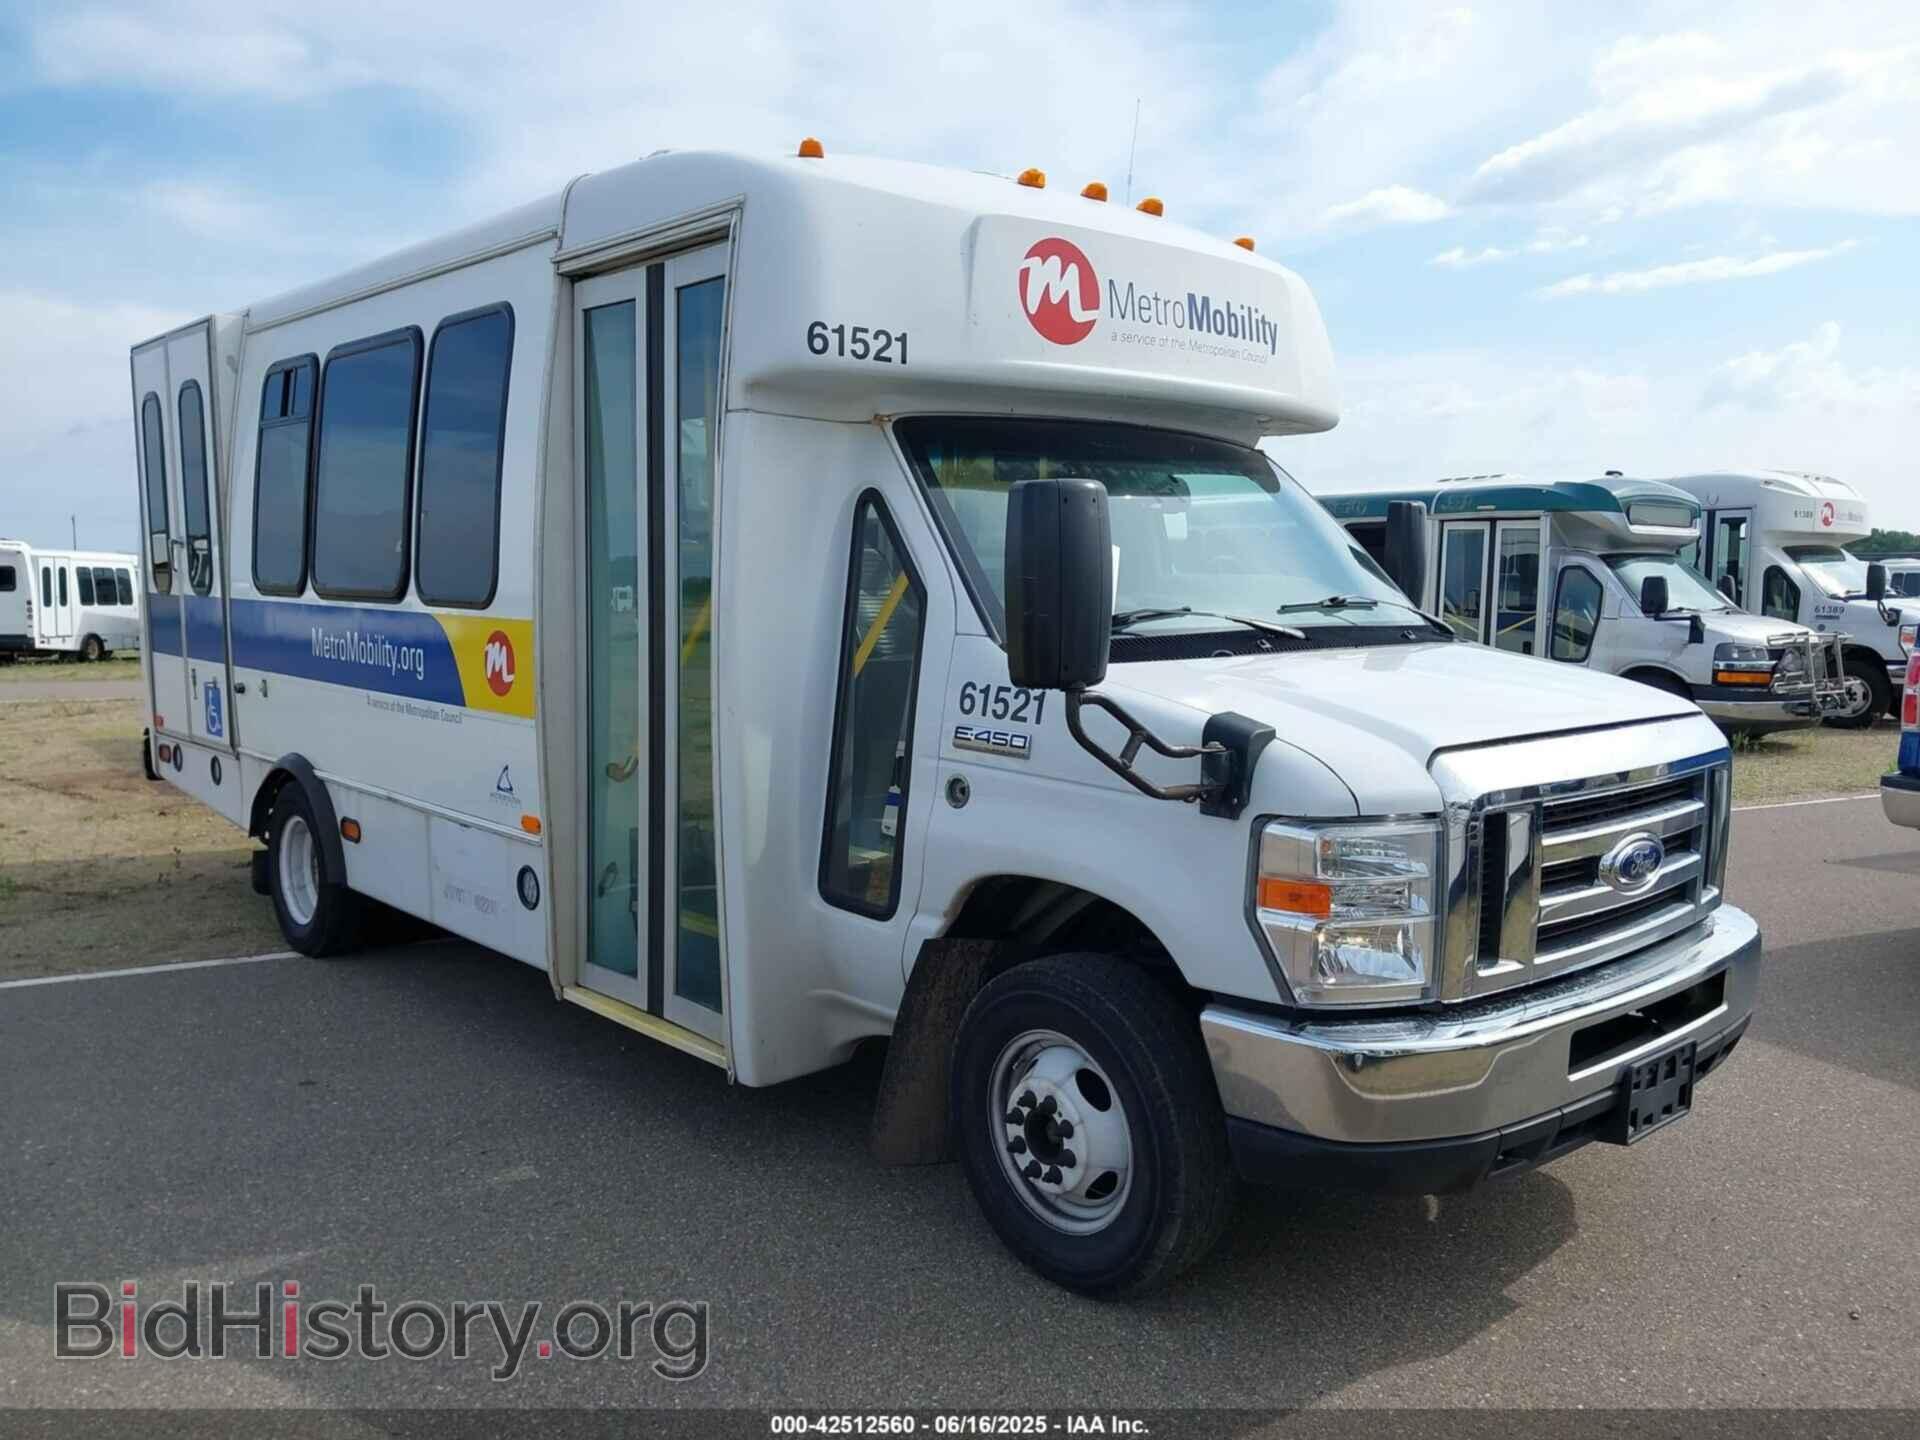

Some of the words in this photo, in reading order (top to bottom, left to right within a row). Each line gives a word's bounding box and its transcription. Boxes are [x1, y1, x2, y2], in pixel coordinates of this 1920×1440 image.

[806, 320, 908, 366] 61521
[1120, 333, 1157, 347] service
[311, 626, 425, 681] MetroMobility.org
[959, 680, 1047, 725] 61521
